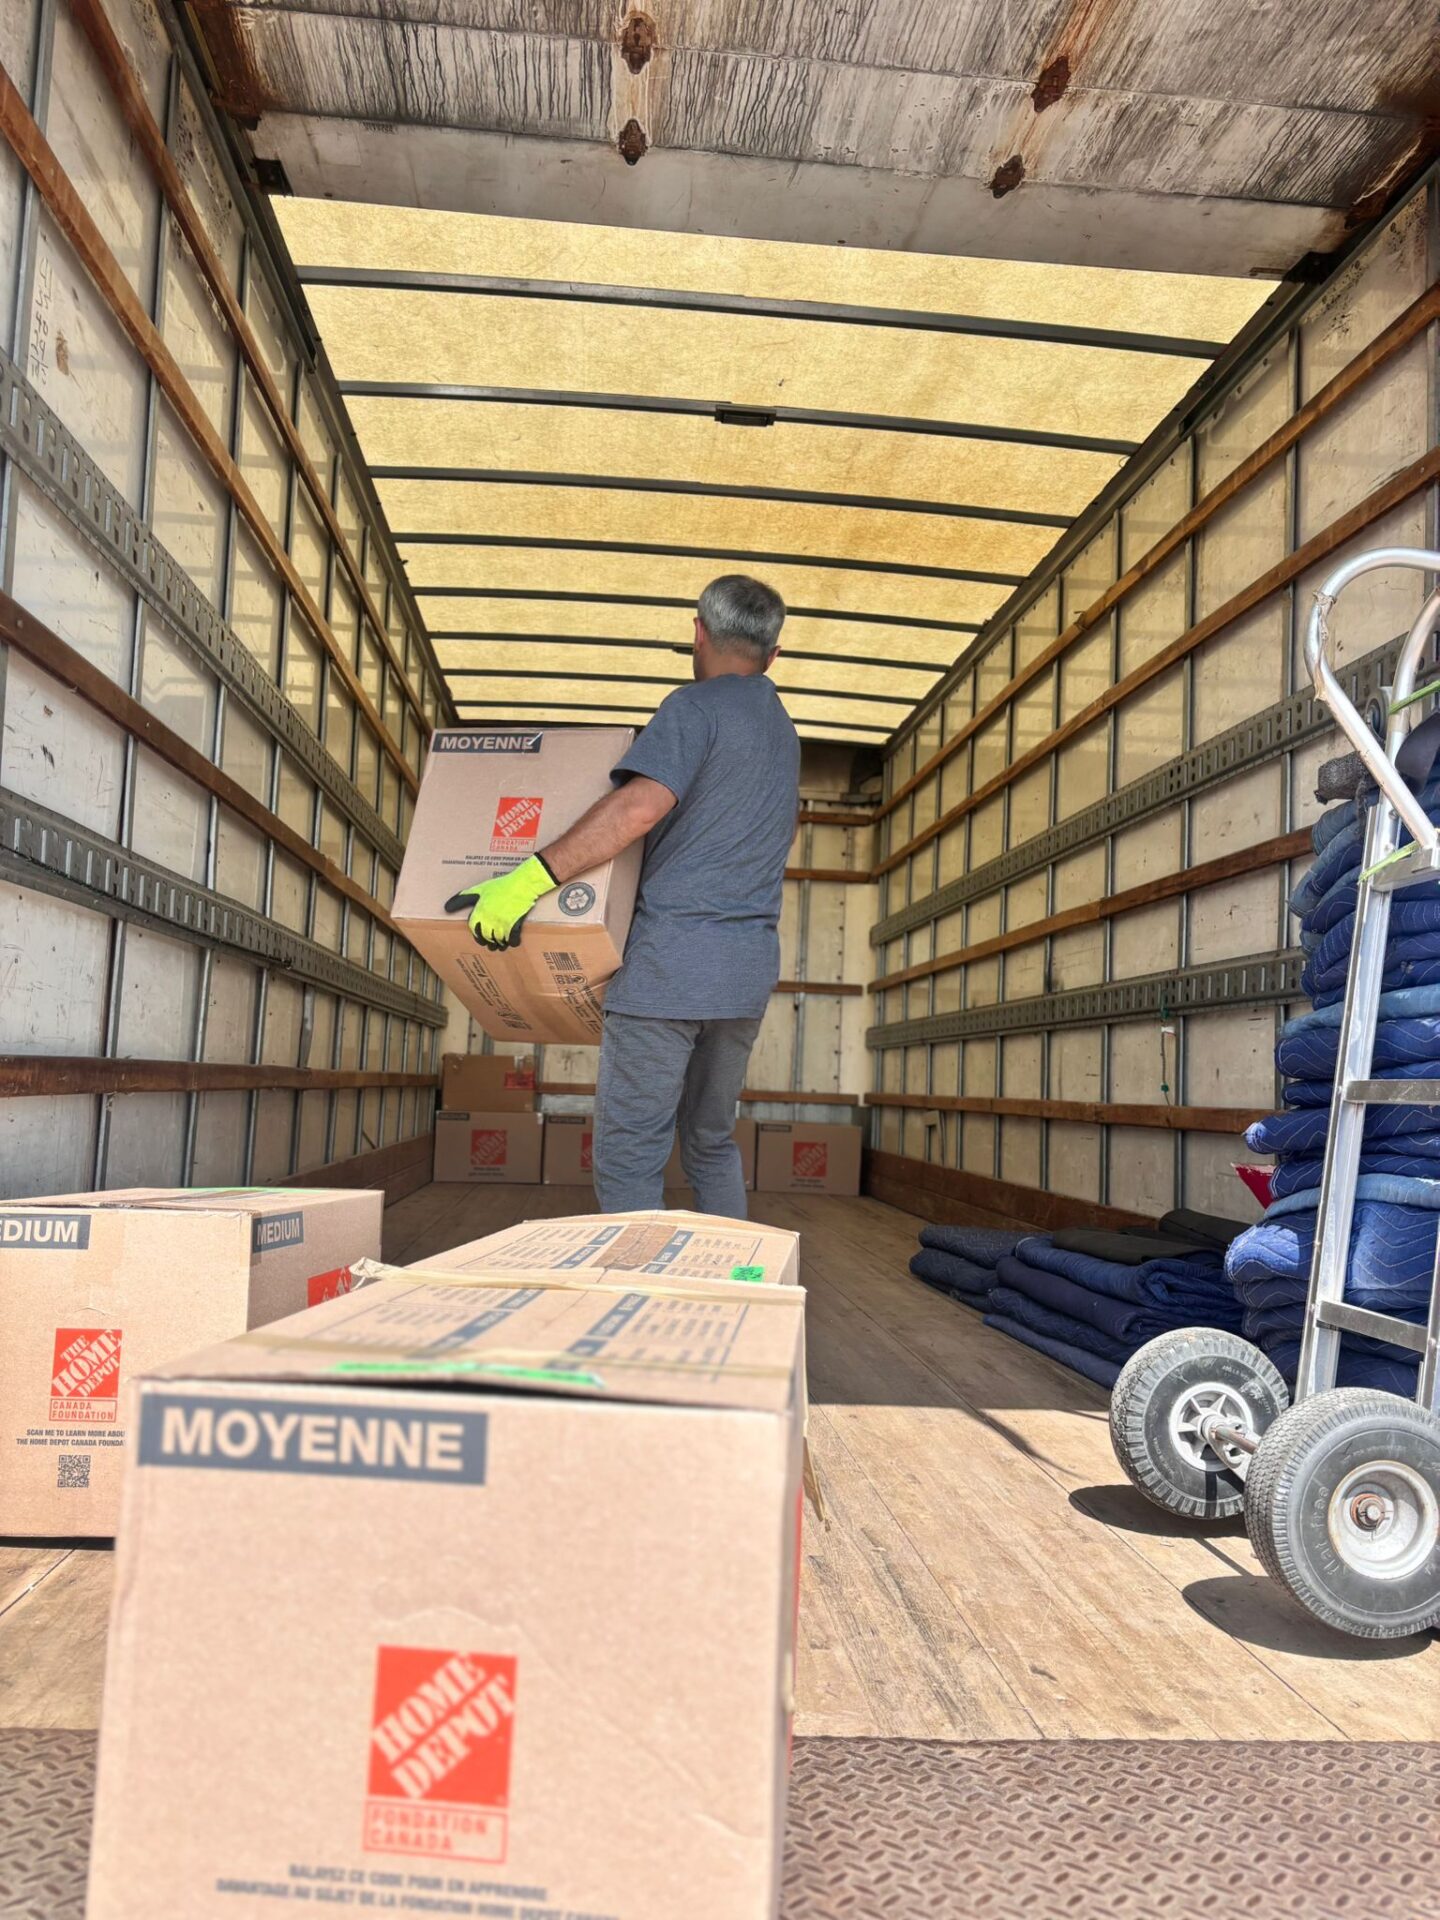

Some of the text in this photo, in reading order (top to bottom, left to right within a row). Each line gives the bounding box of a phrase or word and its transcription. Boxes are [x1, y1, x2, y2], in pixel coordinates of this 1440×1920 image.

[440, 736, 534, 750] MOYENNE
[496, 798, 533, 829] HOME
[501, 802, 542, 837] DEPOT
[257, 1218, 300, 1245] MEDIUM
[52, 1329, 122, 1397] HOME
[61, 1335, 90, 1362] THE
[77, 1354, 120, 1397] DEPOT
[52, 1402, 92, 1410] CANADA
[52, 1410, 114, 1420] FOUNDATION
[161, 1406, 465, 1472] MOYENNE
[373, 1651, 486, 1764] HOME
[391, 1673, 515, 1800] DEPOT
[371, 1808, 487, 1835] FONDATION
[370, 1828, 453, 1850] CANADA
